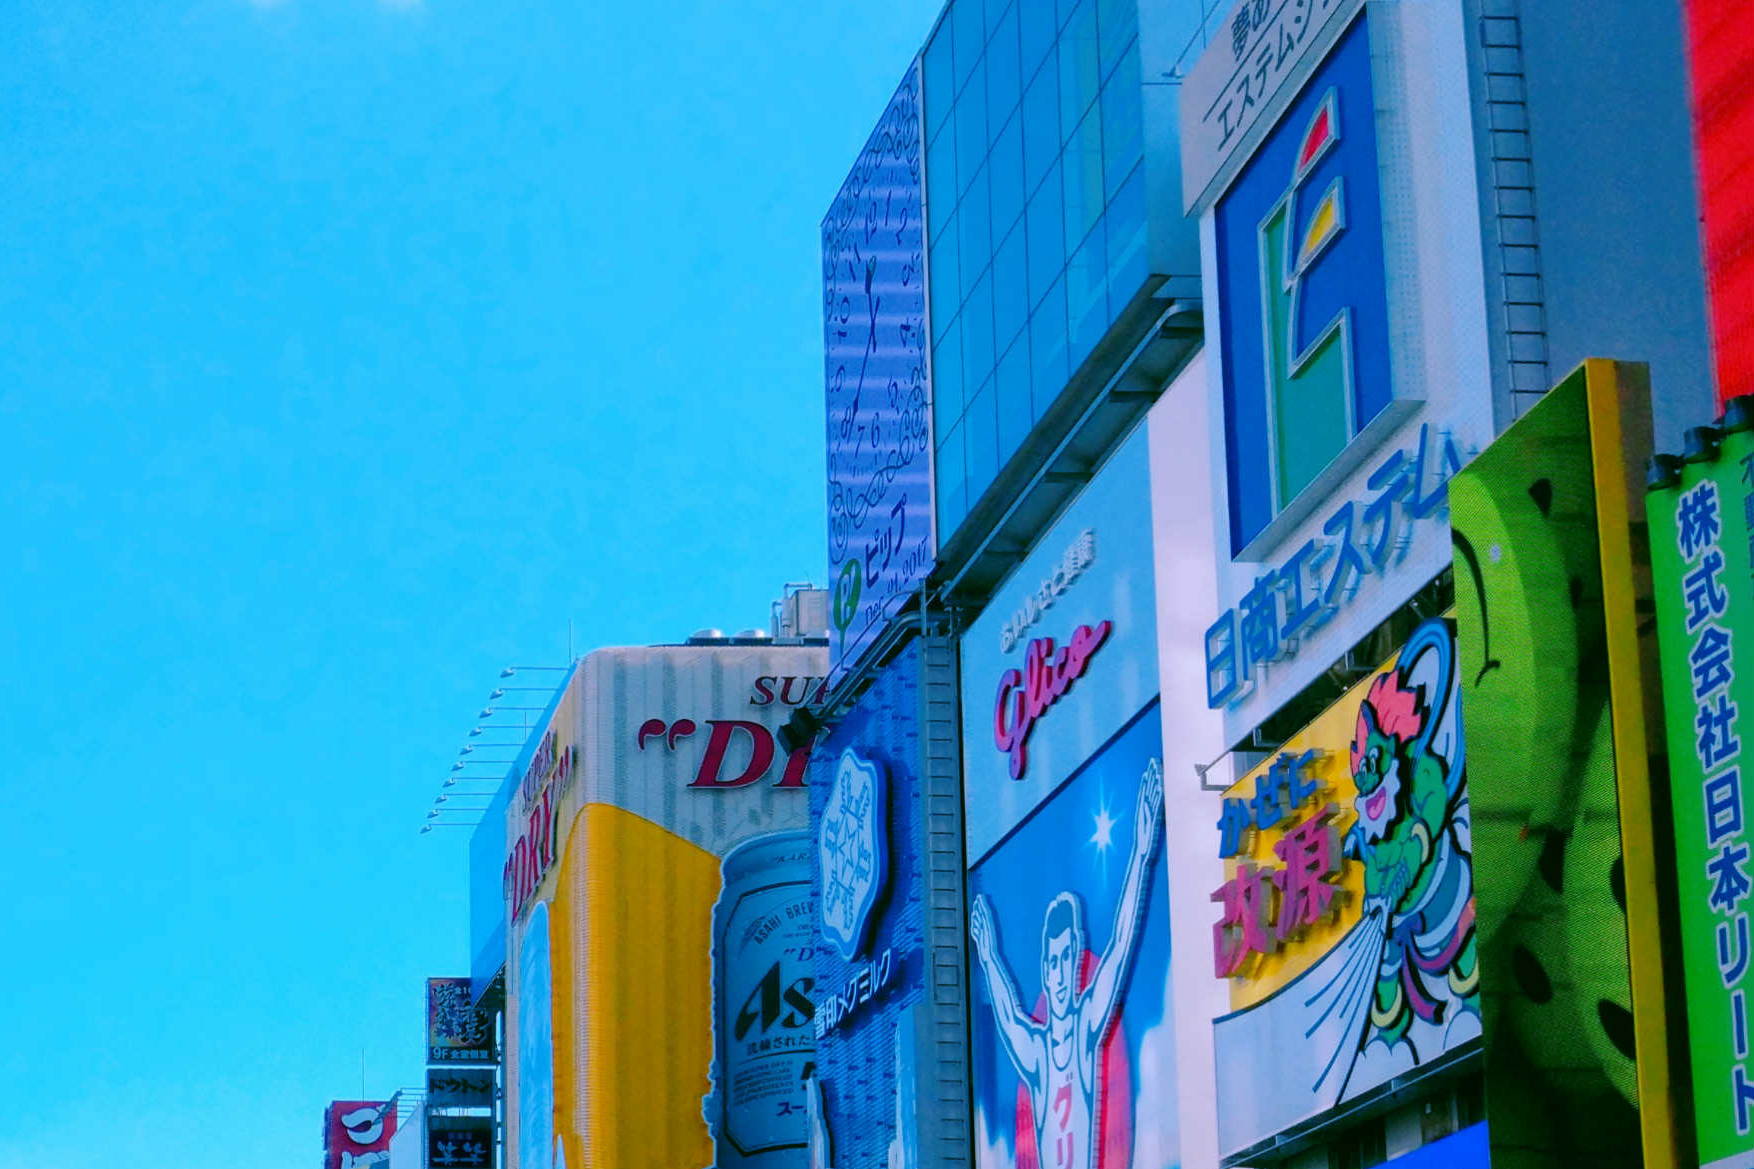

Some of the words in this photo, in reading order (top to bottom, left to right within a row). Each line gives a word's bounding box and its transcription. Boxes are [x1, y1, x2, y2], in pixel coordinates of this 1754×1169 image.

[865, 492, 907, 589] ピップ
[993, 620, 1112, 781] Glico
[1217, 748, 1317, 859] かぜに
[1210, 803, 1330, 979] 改源
[814, 948, 892, 1041] 雪印メグミルク
